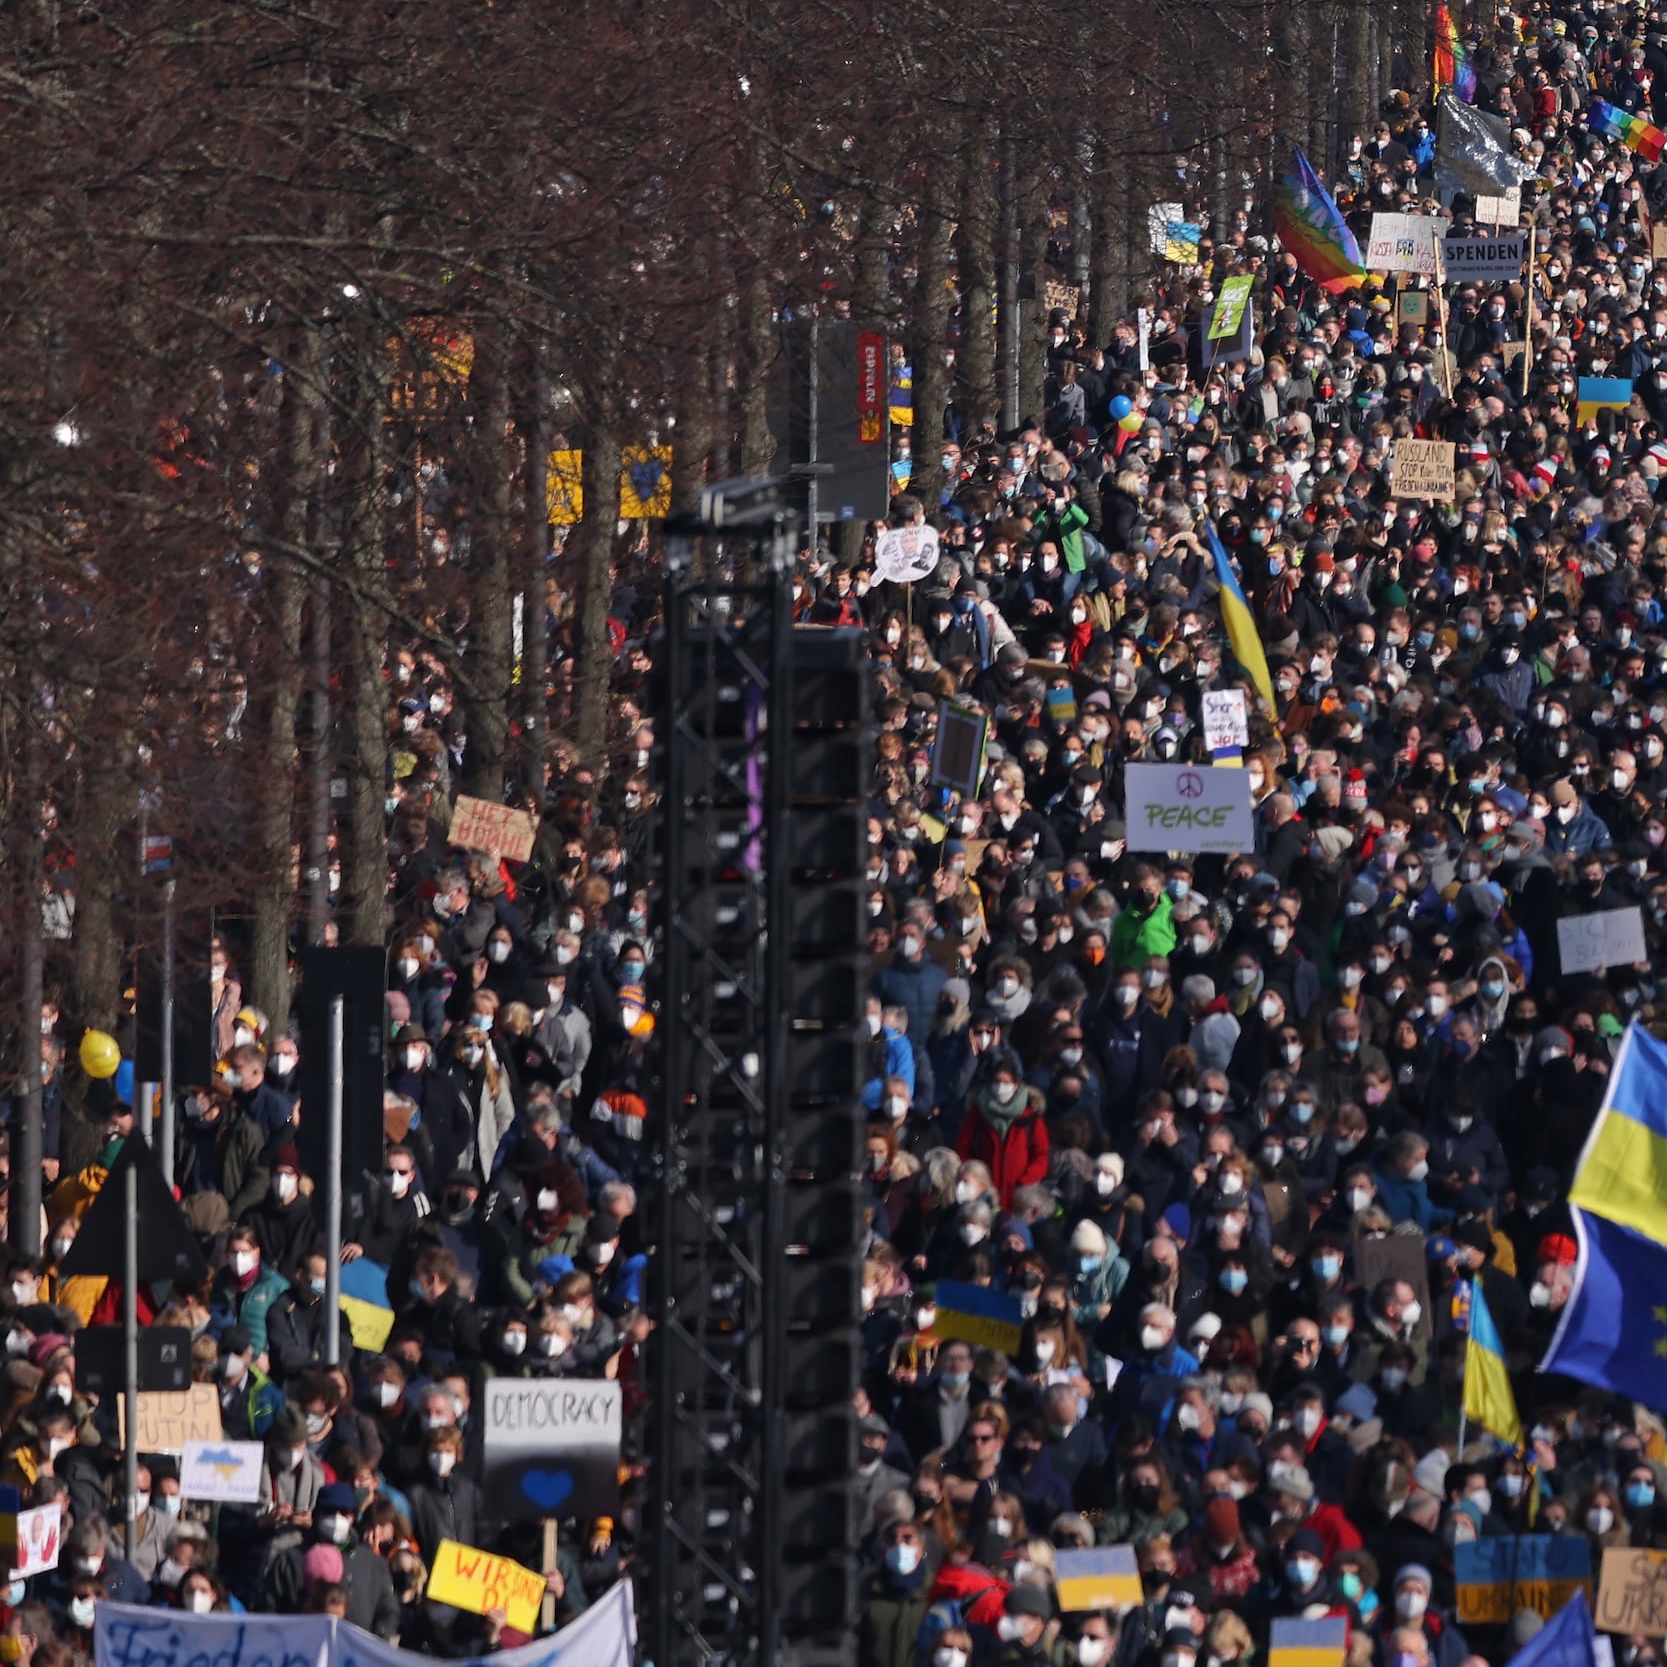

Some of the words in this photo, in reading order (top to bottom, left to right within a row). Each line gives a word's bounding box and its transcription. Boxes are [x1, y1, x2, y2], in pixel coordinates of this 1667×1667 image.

[1446, 244, 1518, 261] SPENDEN
[1396, 442, 1447, 463] RUSSLAND
[1400, 462, 1419, 478] STOP
[1143, 804, 1235, 830] PEACE
[492, 1393, 615, 1428] DEMOCRACY
[456, 1546, 512, 1590] WIR
